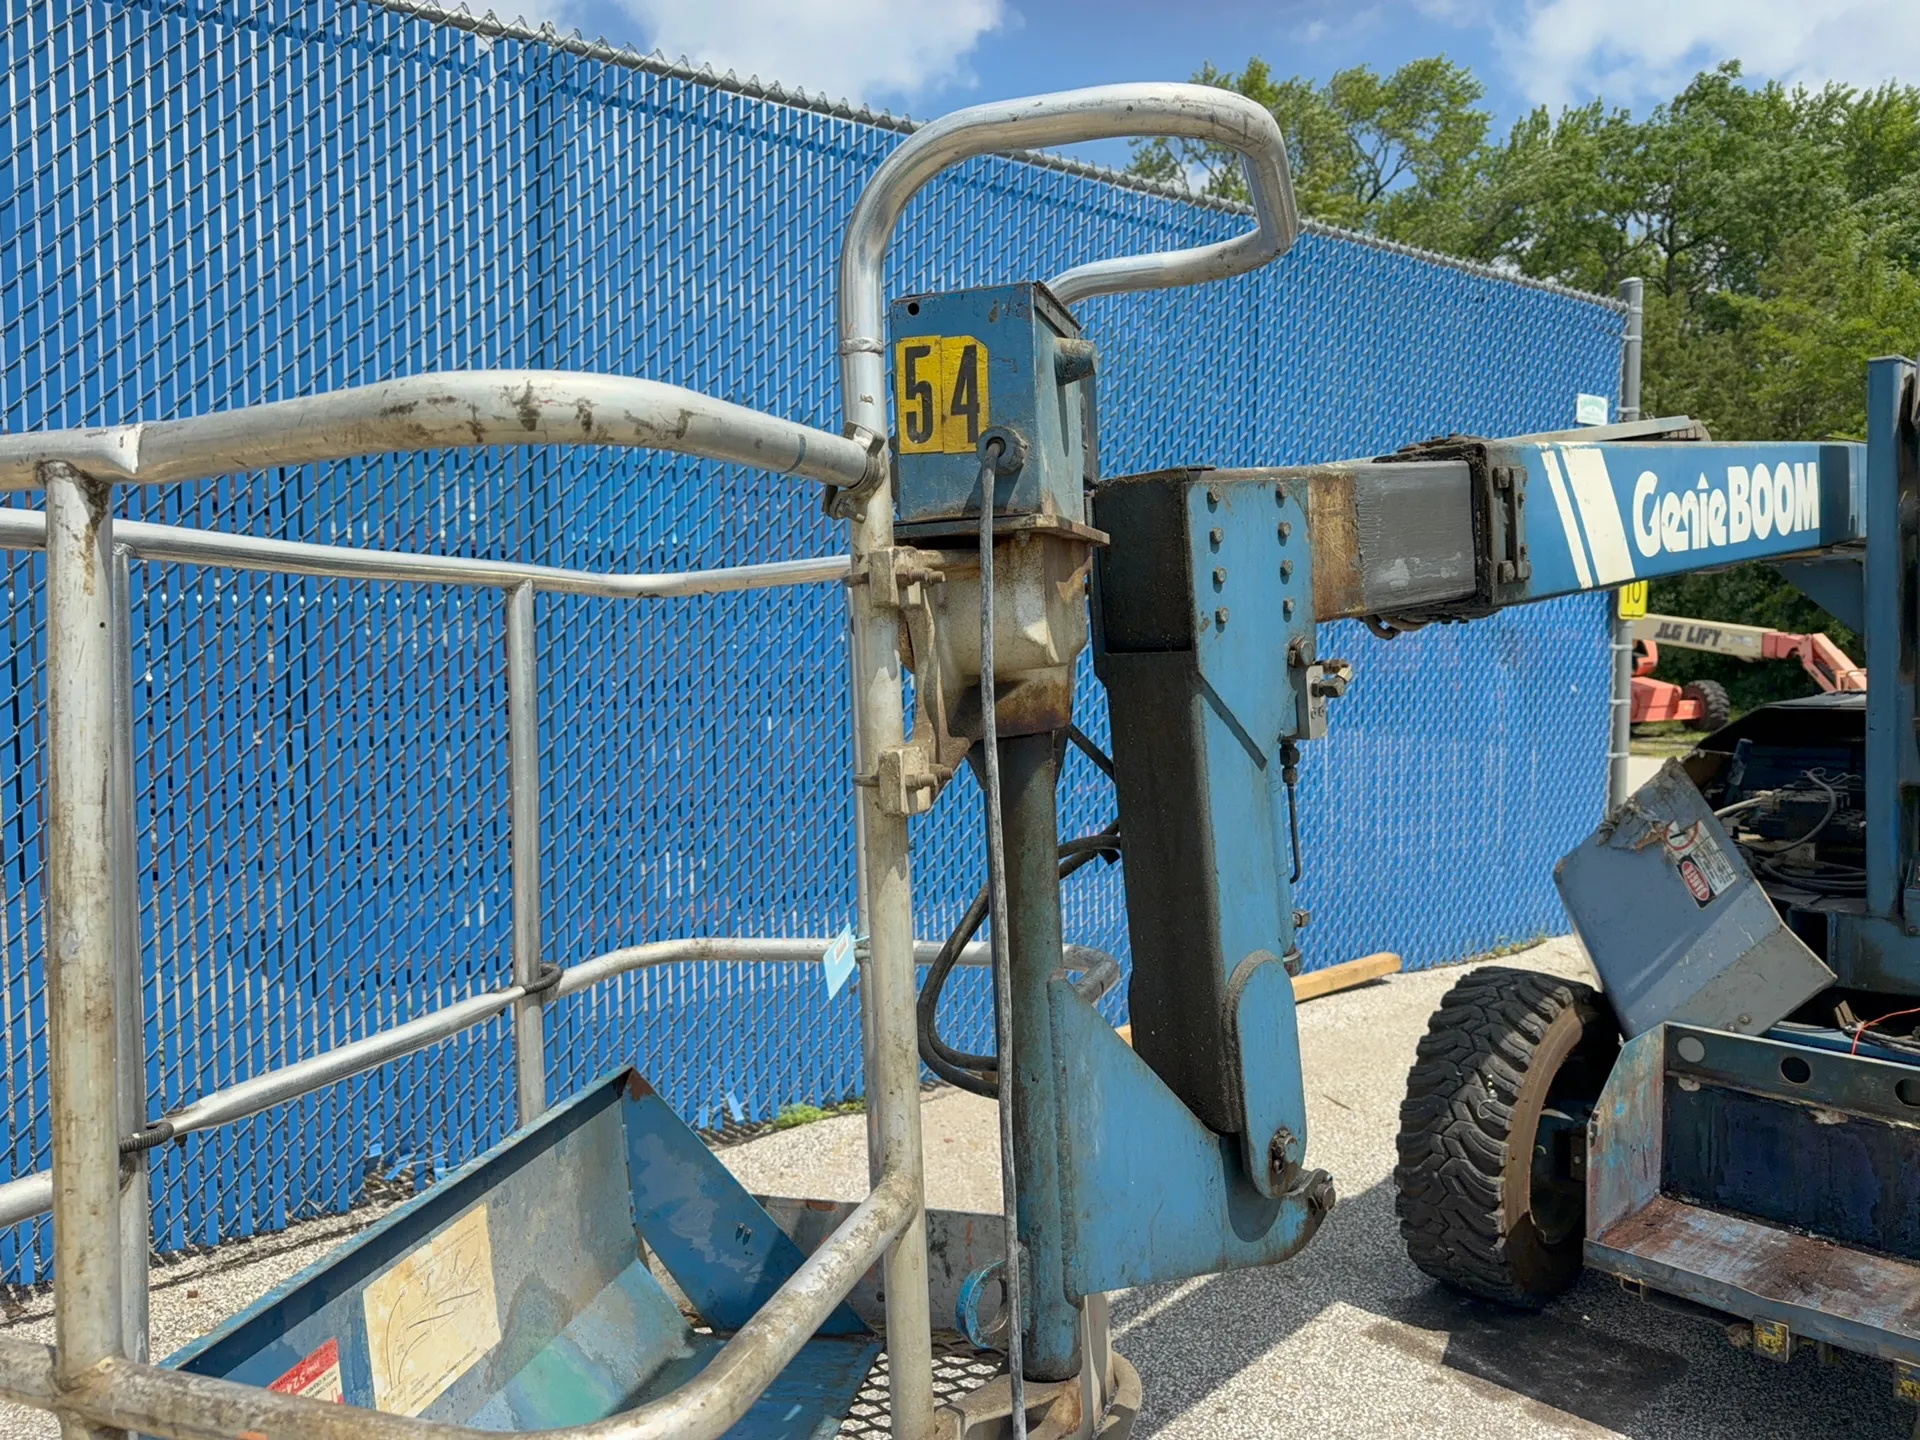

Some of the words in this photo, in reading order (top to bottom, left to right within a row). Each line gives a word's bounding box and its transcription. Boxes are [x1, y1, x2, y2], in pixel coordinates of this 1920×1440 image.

[904, 345, 980, 444] 54
[1654, 622, 1684, 641] JLG
[1686, 625, 1722, 647] LIFT
[1684, 864, 1708, 898] DANGER
